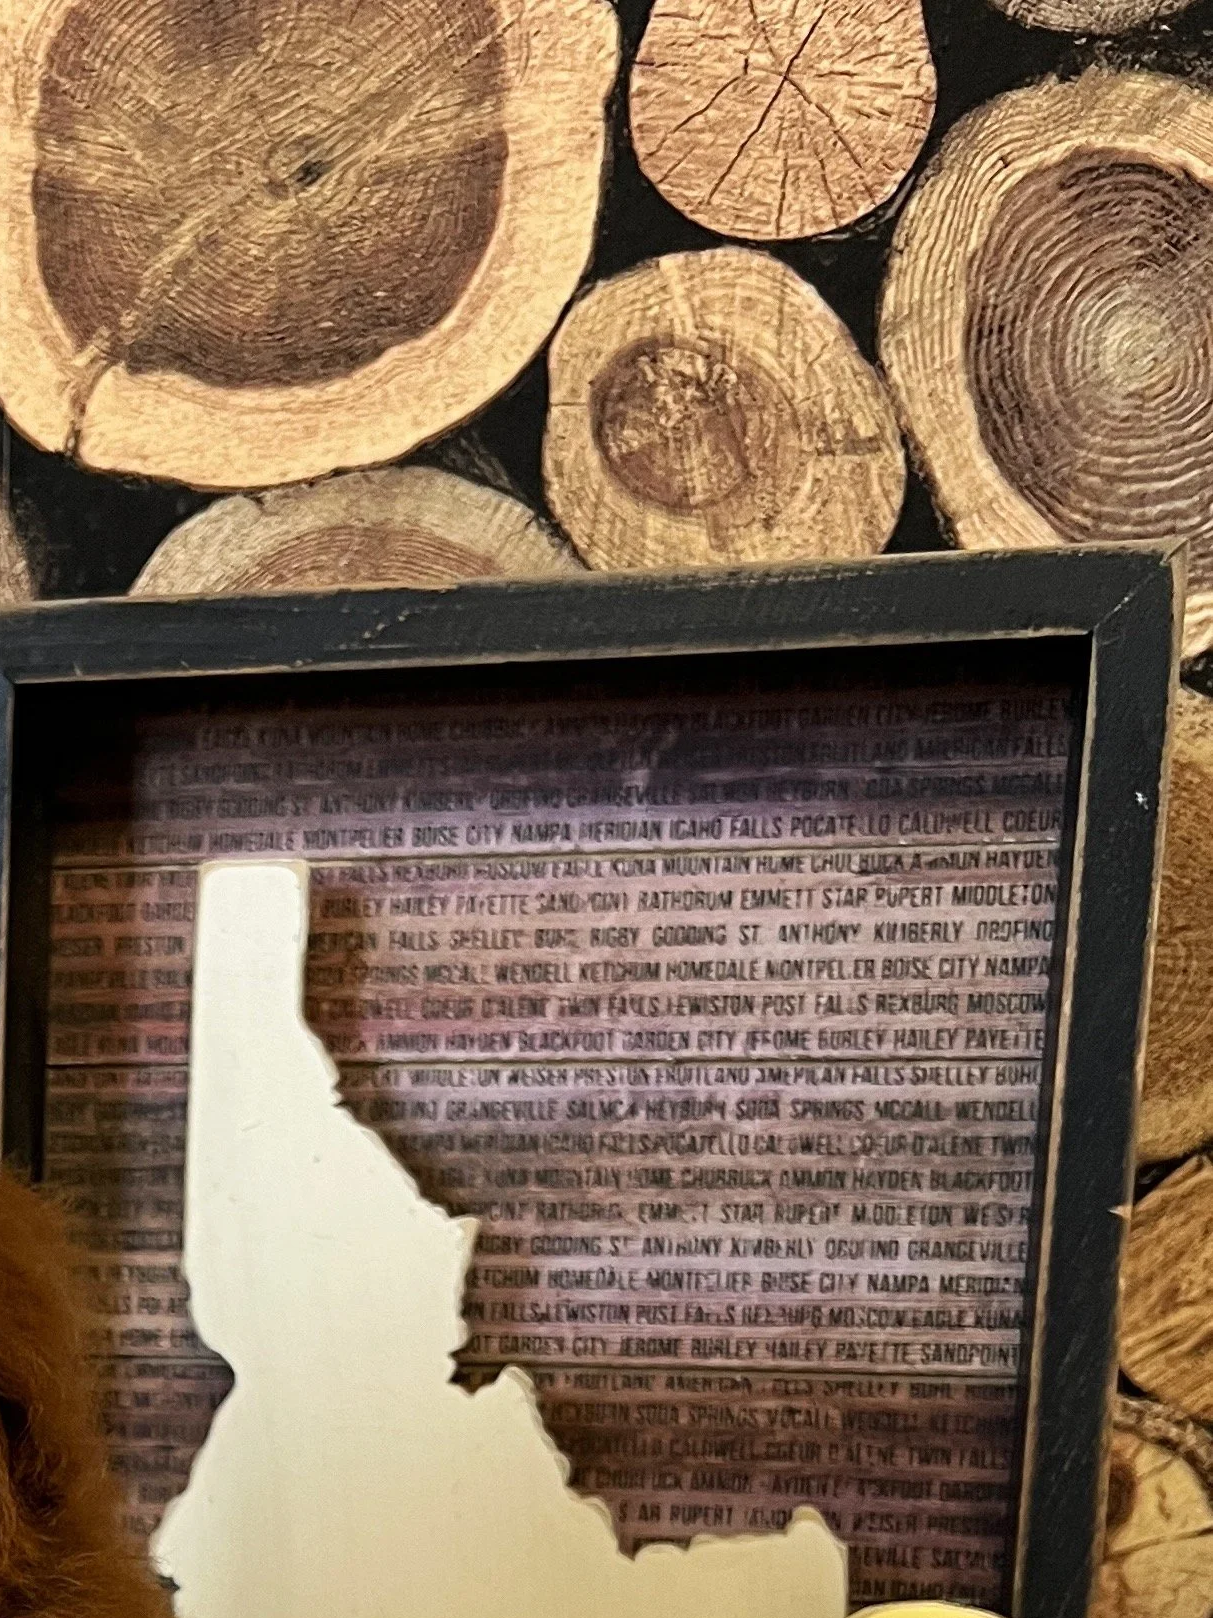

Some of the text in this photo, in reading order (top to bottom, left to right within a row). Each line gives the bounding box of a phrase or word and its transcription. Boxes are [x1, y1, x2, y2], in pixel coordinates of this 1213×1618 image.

[411, 824, 459, 846] BOISE
[465, 823, 506, 845] CITY
[511, 821, 572, 844] NAMPA
[579, 819, 663, 842] MERIDIAN
[729, 816, 782, 839] FALLS
[790, 813, 892, 837] POCATELLO
[898, 811, 997, 835] CALDWELL
[610, 858, 657, 877] KUNA
[660, 856, 753, 876] MOUNTAIN
[755, 855, 803, 874] HOME
[637, 889, 733, 912] RATHDRUM
[739, 887, 814, 910] EMMETT
[820, 886, 867, 909] STAR
[873, 885, 944, 908] RUPERT
[950, 882, 1055, 906] MIDDLETON
[388, 929, 441, 951] FALLS
[589, 926, 640, 948] RIGBY
[651, 924, 727, 947] GOODING
[777, 922, 863, 945] ANTHONY
[872, 920, 964, 944] KIMBERLY
[665, 959, 758, 982] HOMEDALE
[763, 958, 876, 981] MONTPELIER
[880, 957, 933, 979] BOISE
[937, 956, 983, 978] CITY
[984, 955, 1050, 978] NAMPA
[761, 994, 808, 1016] POST
[874, 992, 960, 1015] REXBURG
[966, 991, 1048, 1014] MOSCOW
[696, 1030, 737, 1051] CITY
[817, 1029, 890, 1051] BURLEY
[892, 1028, 956, 1050] HAILEY
[963, 1027, 1044, 1050] PAYETTE
[851, 1066, 907, 1085] FALLS
[719, 1203, 764, 1224] STAR
[817, 1273, 860, 1294] CITY
[866, 1273, 931, 1295] NAMPA
